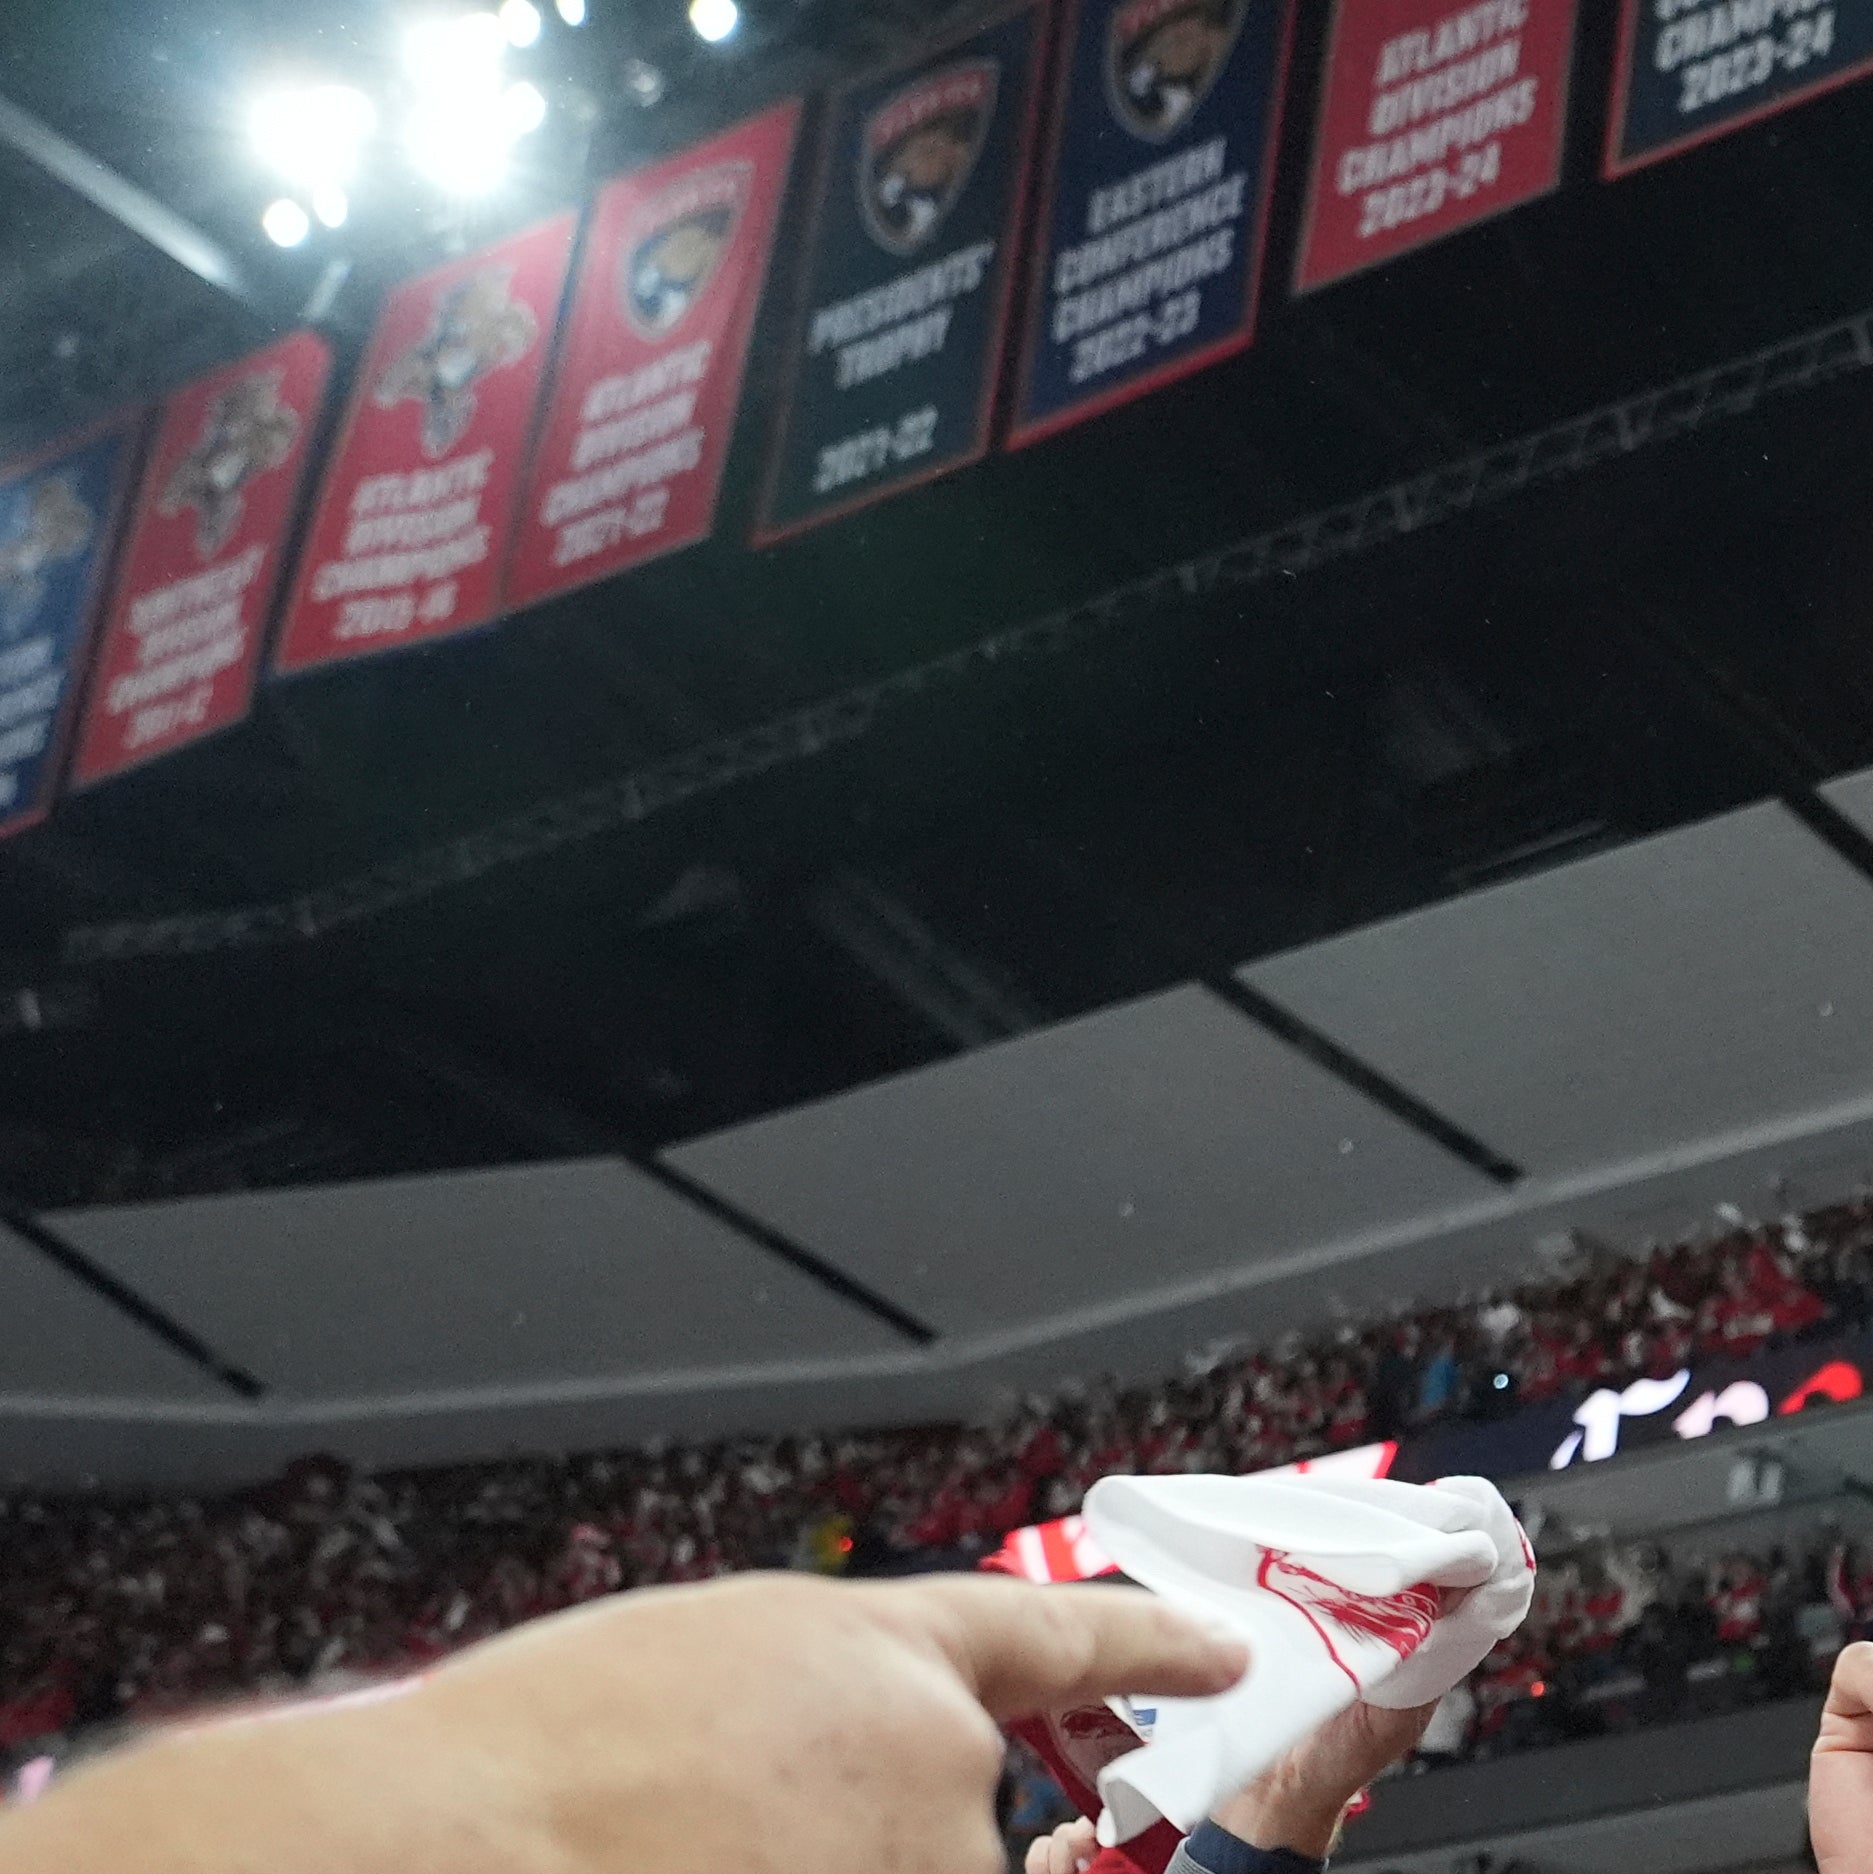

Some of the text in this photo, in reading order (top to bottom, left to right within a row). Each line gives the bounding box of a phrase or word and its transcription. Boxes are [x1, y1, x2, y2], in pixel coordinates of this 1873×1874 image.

[1370, 35, 1522, 136] DIVISION
[1680, 9, 1835, 113] 2023-24
[1337, 75, 1540, 195] CHAMPIONS
[1357, 141, 1500, 239] 2023-24
[1054, 227, 1236, 344] CHAMPIONS
